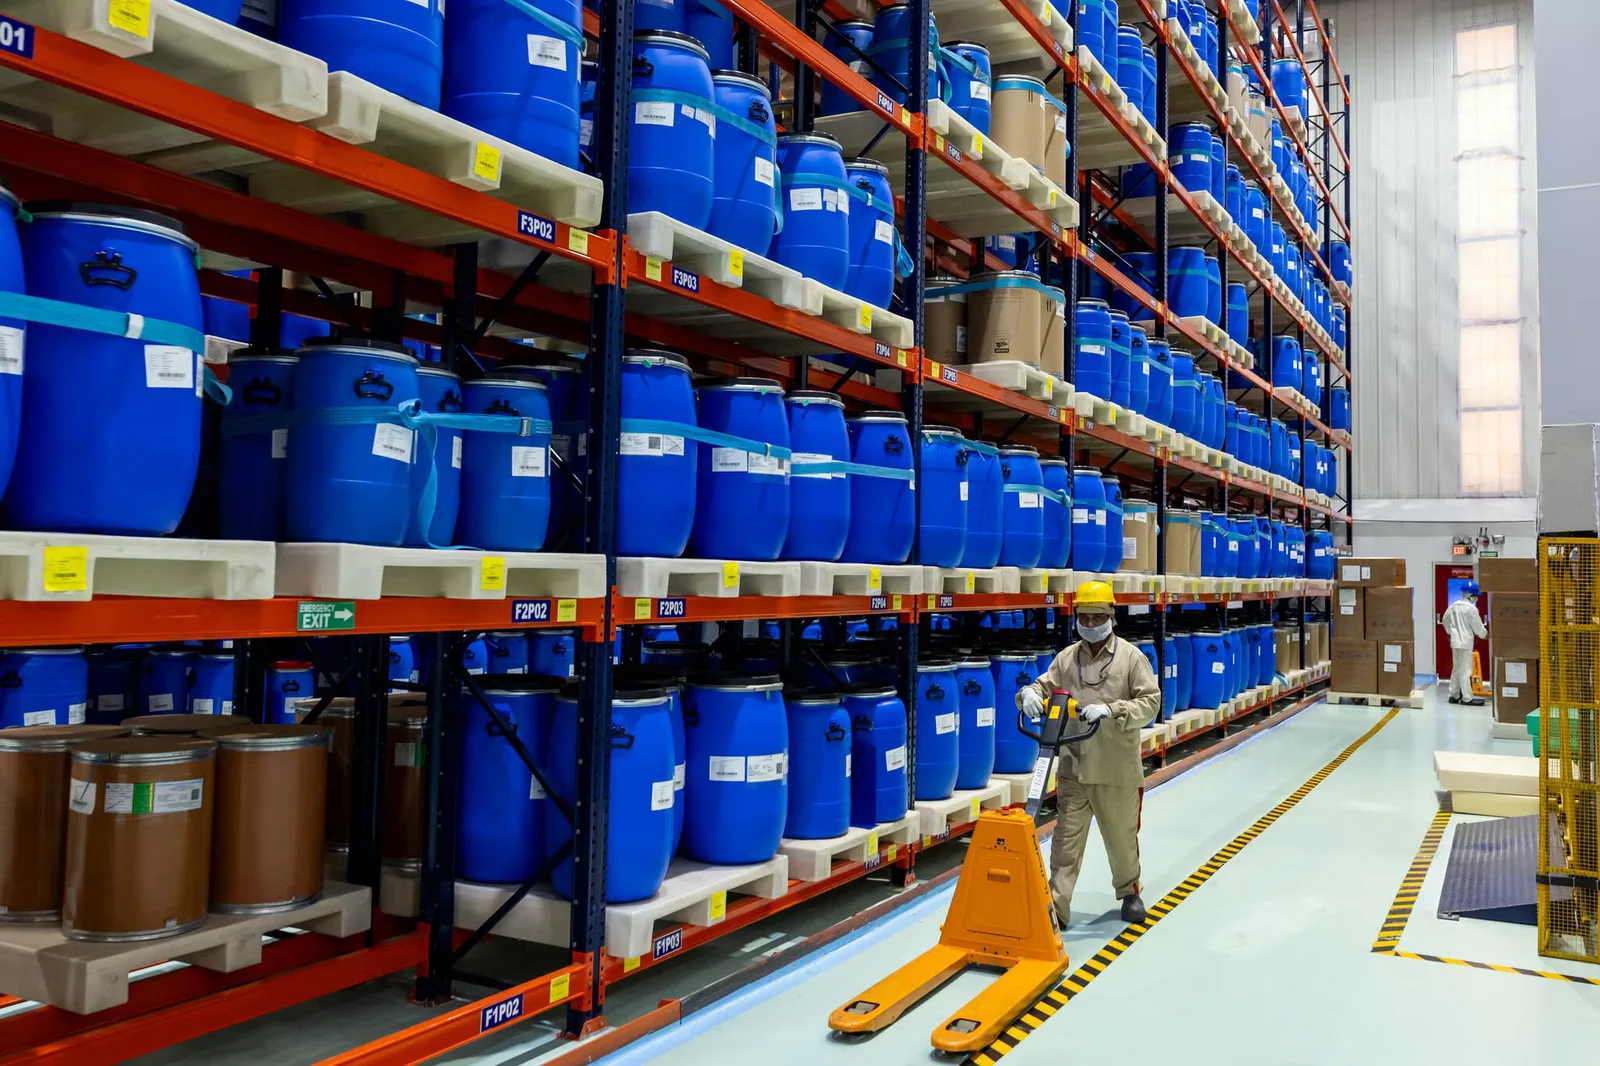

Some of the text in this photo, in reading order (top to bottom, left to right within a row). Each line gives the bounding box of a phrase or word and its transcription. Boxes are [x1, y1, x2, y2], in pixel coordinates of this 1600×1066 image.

[521, 213, 553, 240] F3P02
[674, 269, 697, 290] F3P03
[300, 604, 335, 613] EMERGENCY
[515, 603, 547, 620] F2P02
[660, 601, 683, 616] F2P03
[872, 597, 887, 609] F2P04
[302, 613, 330, 629] EXIT
[656, 932, 680, 957] F1P03
[485, 997, 519, 1028] F1P02
